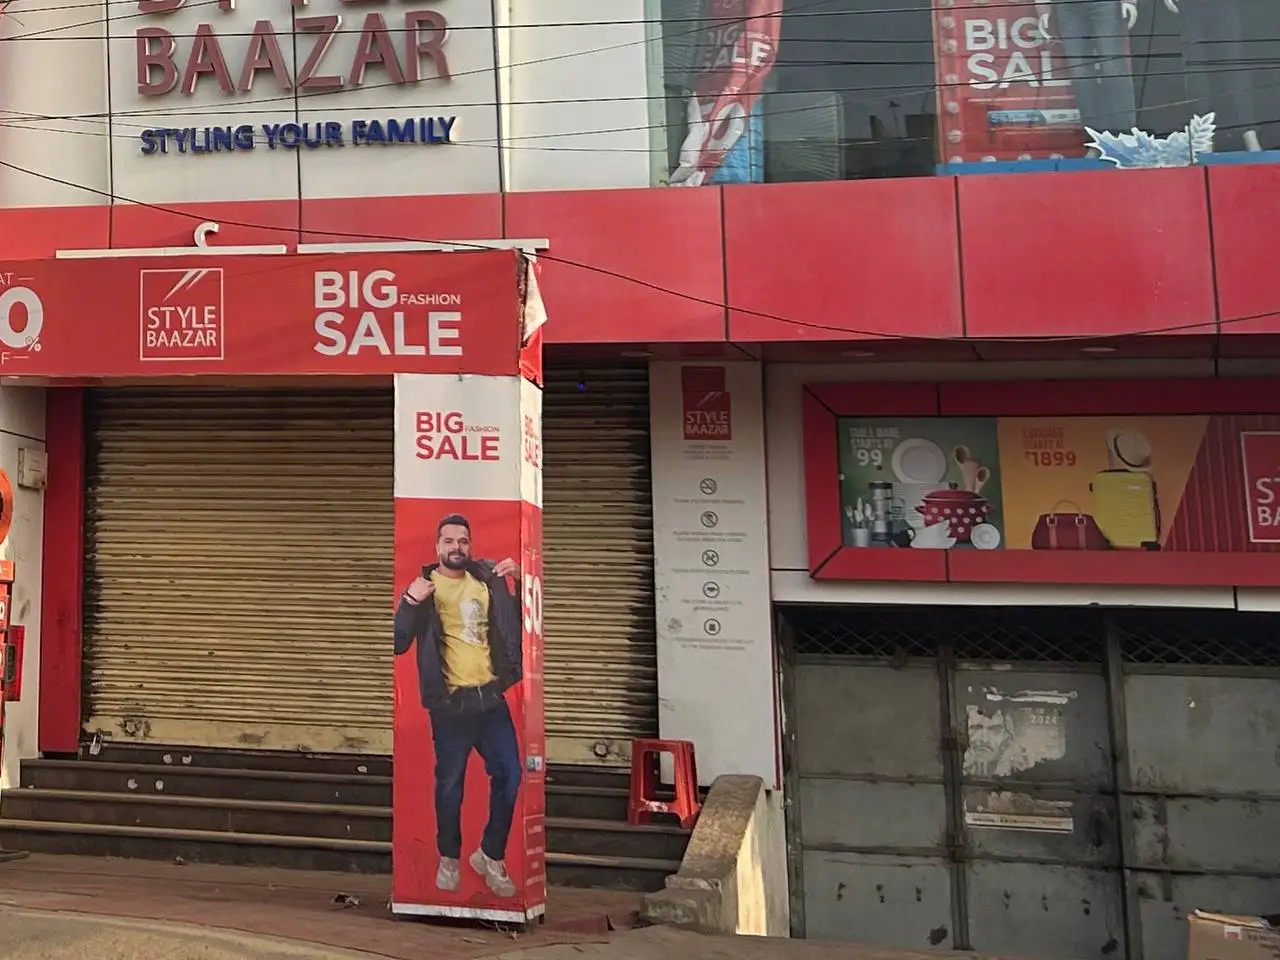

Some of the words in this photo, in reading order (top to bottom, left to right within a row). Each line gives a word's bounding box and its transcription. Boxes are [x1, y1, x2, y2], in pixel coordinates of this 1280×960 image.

[965, 17, 1040, 51] BIG
[136, 10, 452, 96] BAAZAR
[967, 51, 1072, 90] SAL
[140, 126, 256, 155] STYLING
[262, 121, 345, 150] YOUR
[351, 116, 458, 146] FAMILY
[314, 270, 398, 309] BIG
[400, 293, 461, 306] FASHION
[147, 305, 217, 329] STYLE
[146, 330, 217, 347] BAAZAR
[314, 311, 463, 356] SALE
[415, 412, 464, 434] BIG
[464, 425, 500, 433] FASHION
[685, 424, 730, 435] BAAZAR
[686, 411, 729, 424] STYLE
[415, 436, 500, 461] SALE
